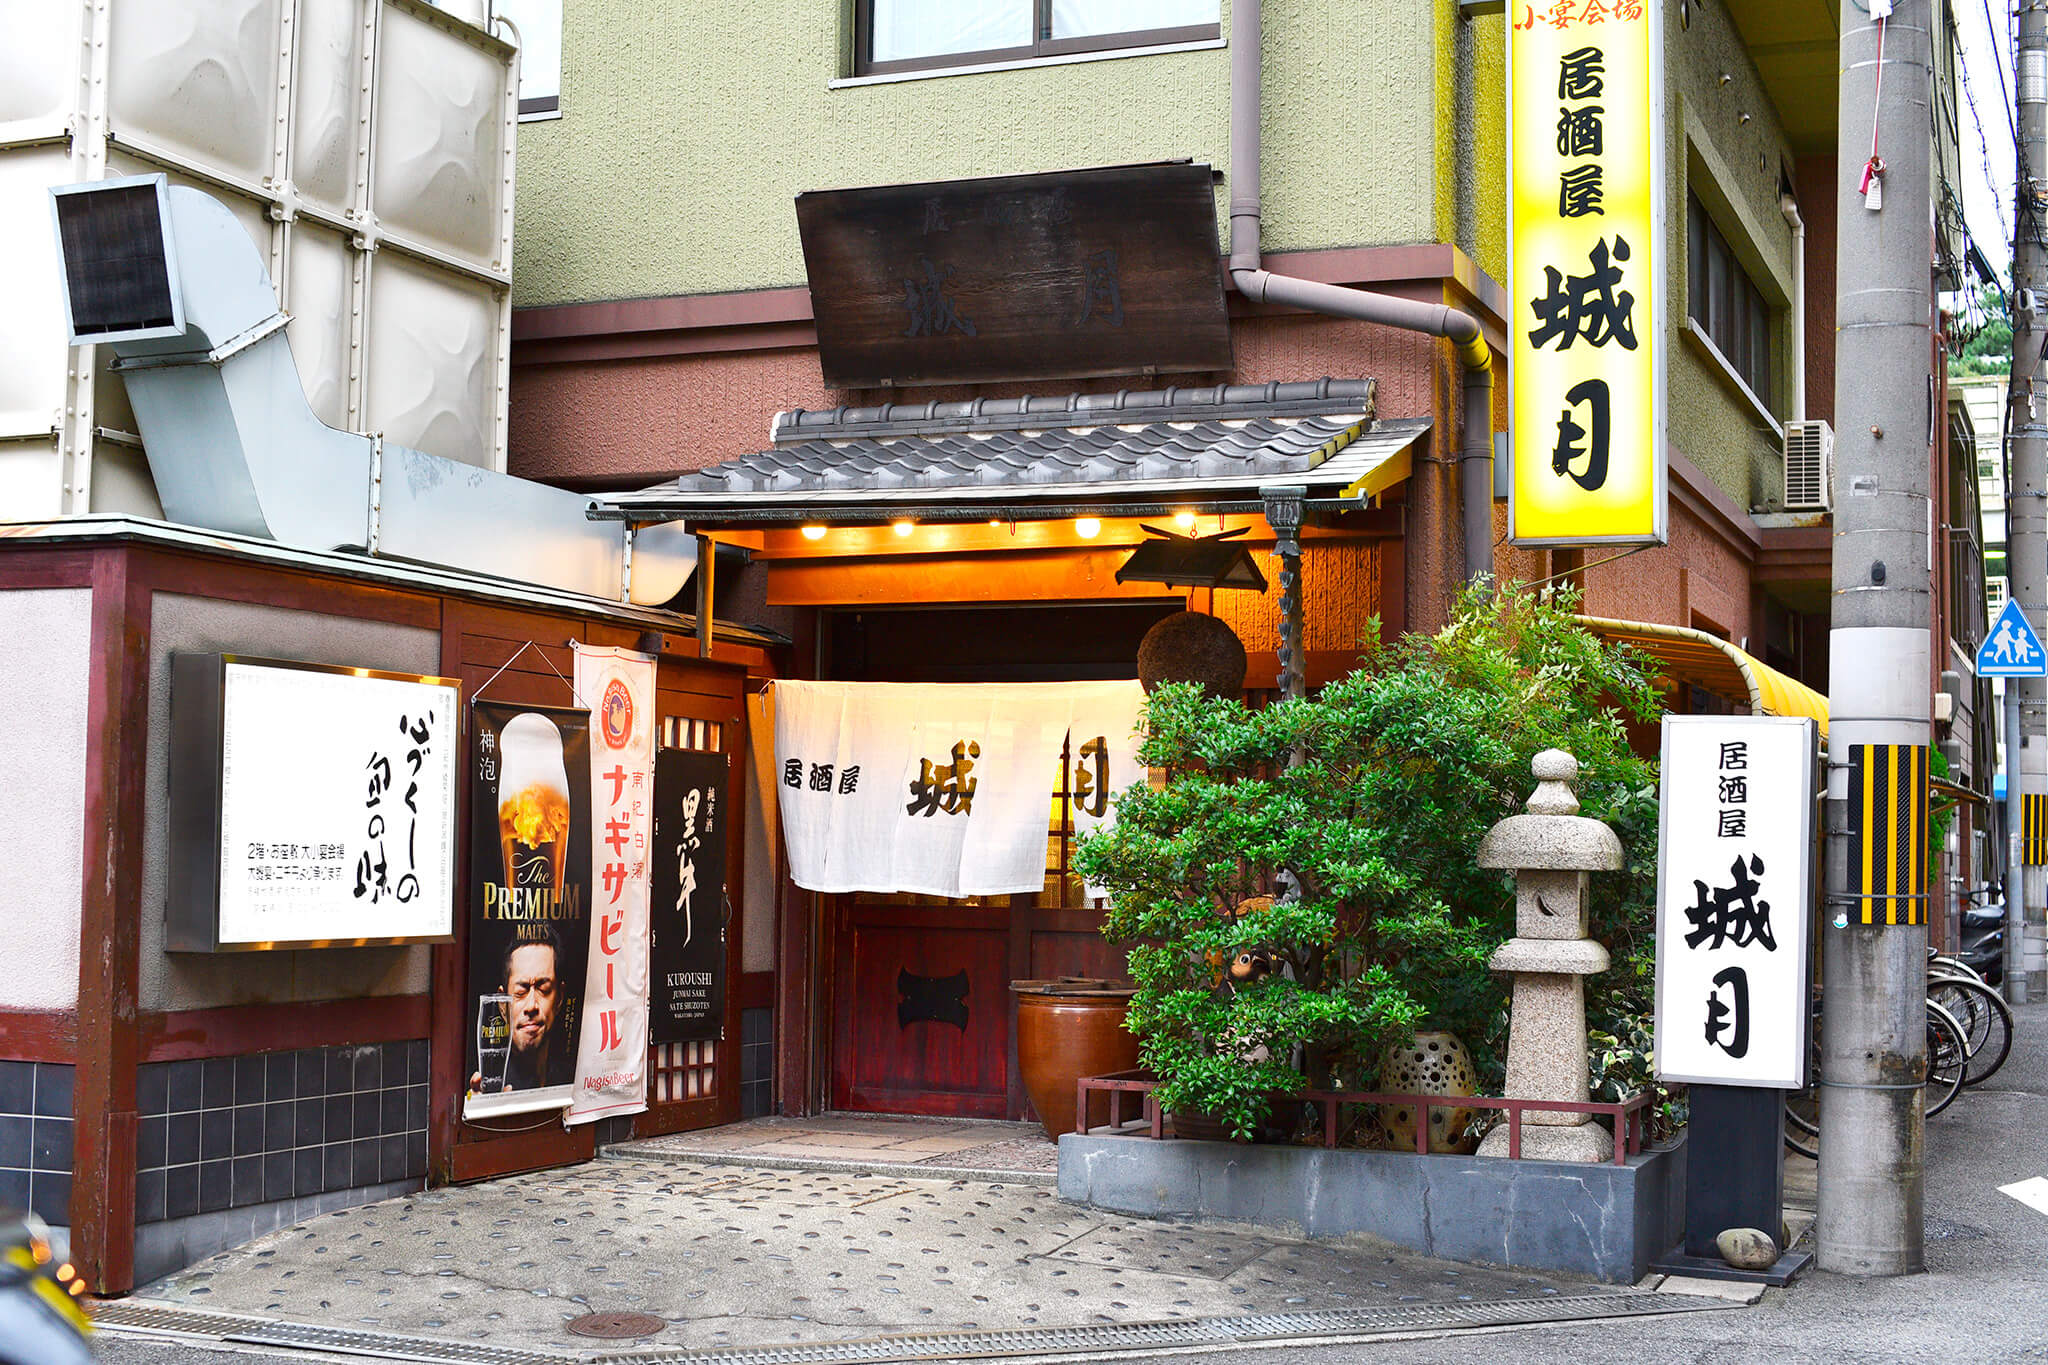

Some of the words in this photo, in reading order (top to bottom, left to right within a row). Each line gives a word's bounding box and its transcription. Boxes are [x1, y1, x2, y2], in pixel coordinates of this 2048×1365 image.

[1557, 47, 1605, 217] 居酒屋
[1529, 235, 1637, 491] 城月
[705, 787, 716, 832] 純米酒
[784, 759, 860, 794] 居酒屋
[1718, 741, 1747, 837] 居酒屋
[483, 881, 580, 920] PREMIUM
[510, 853, 554, 884] The
[677, 788, 700, 948] 黒牛
[601, 766, 630, 1052] ナギサビール
[667, 972, 712, 987] KUROUSHI
[1684, 853, 1777, 1058] 城月
[691, 989, 706, 997] SAKE
